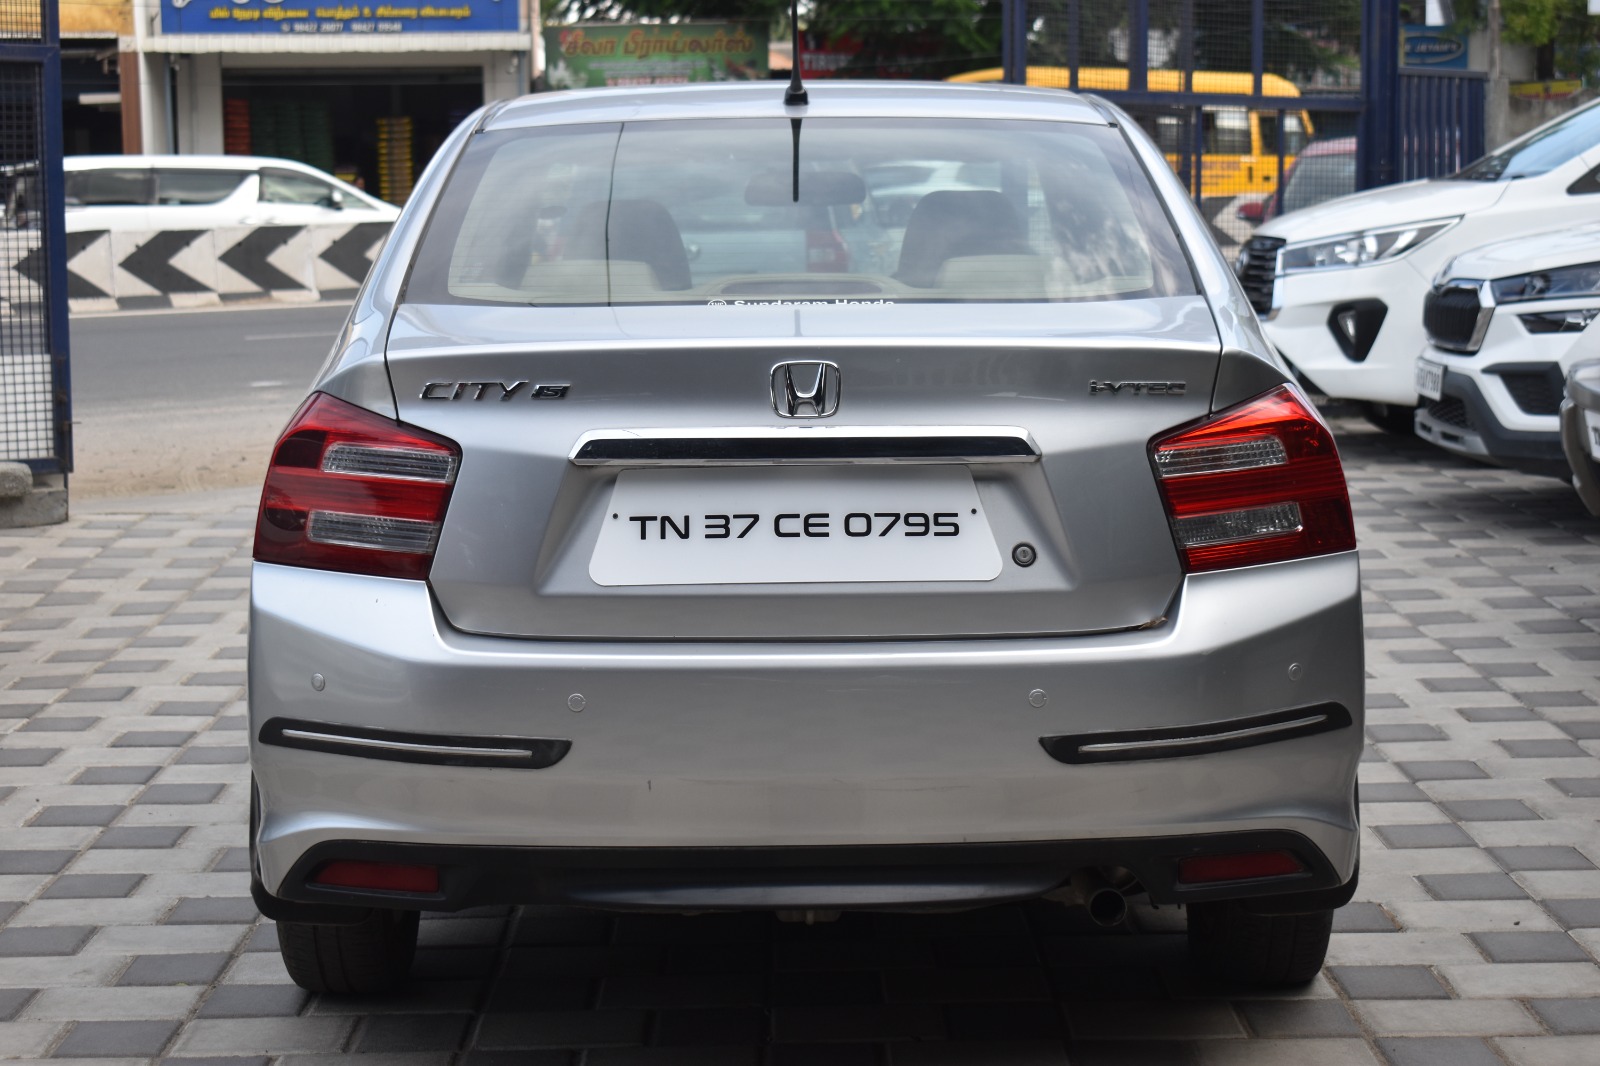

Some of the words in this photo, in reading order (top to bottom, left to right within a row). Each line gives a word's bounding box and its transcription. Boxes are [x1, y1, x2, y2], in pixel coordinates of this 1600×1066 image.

[419, 380, 529, 401] CITY
[1089, 380, 1186, 396] i-VTEC
[629, 515, 690, 540] TN
[704, 514, 760, 539] 37
[773, 513, 830, 538] CE
[844, 512, 960, 537] 0795
